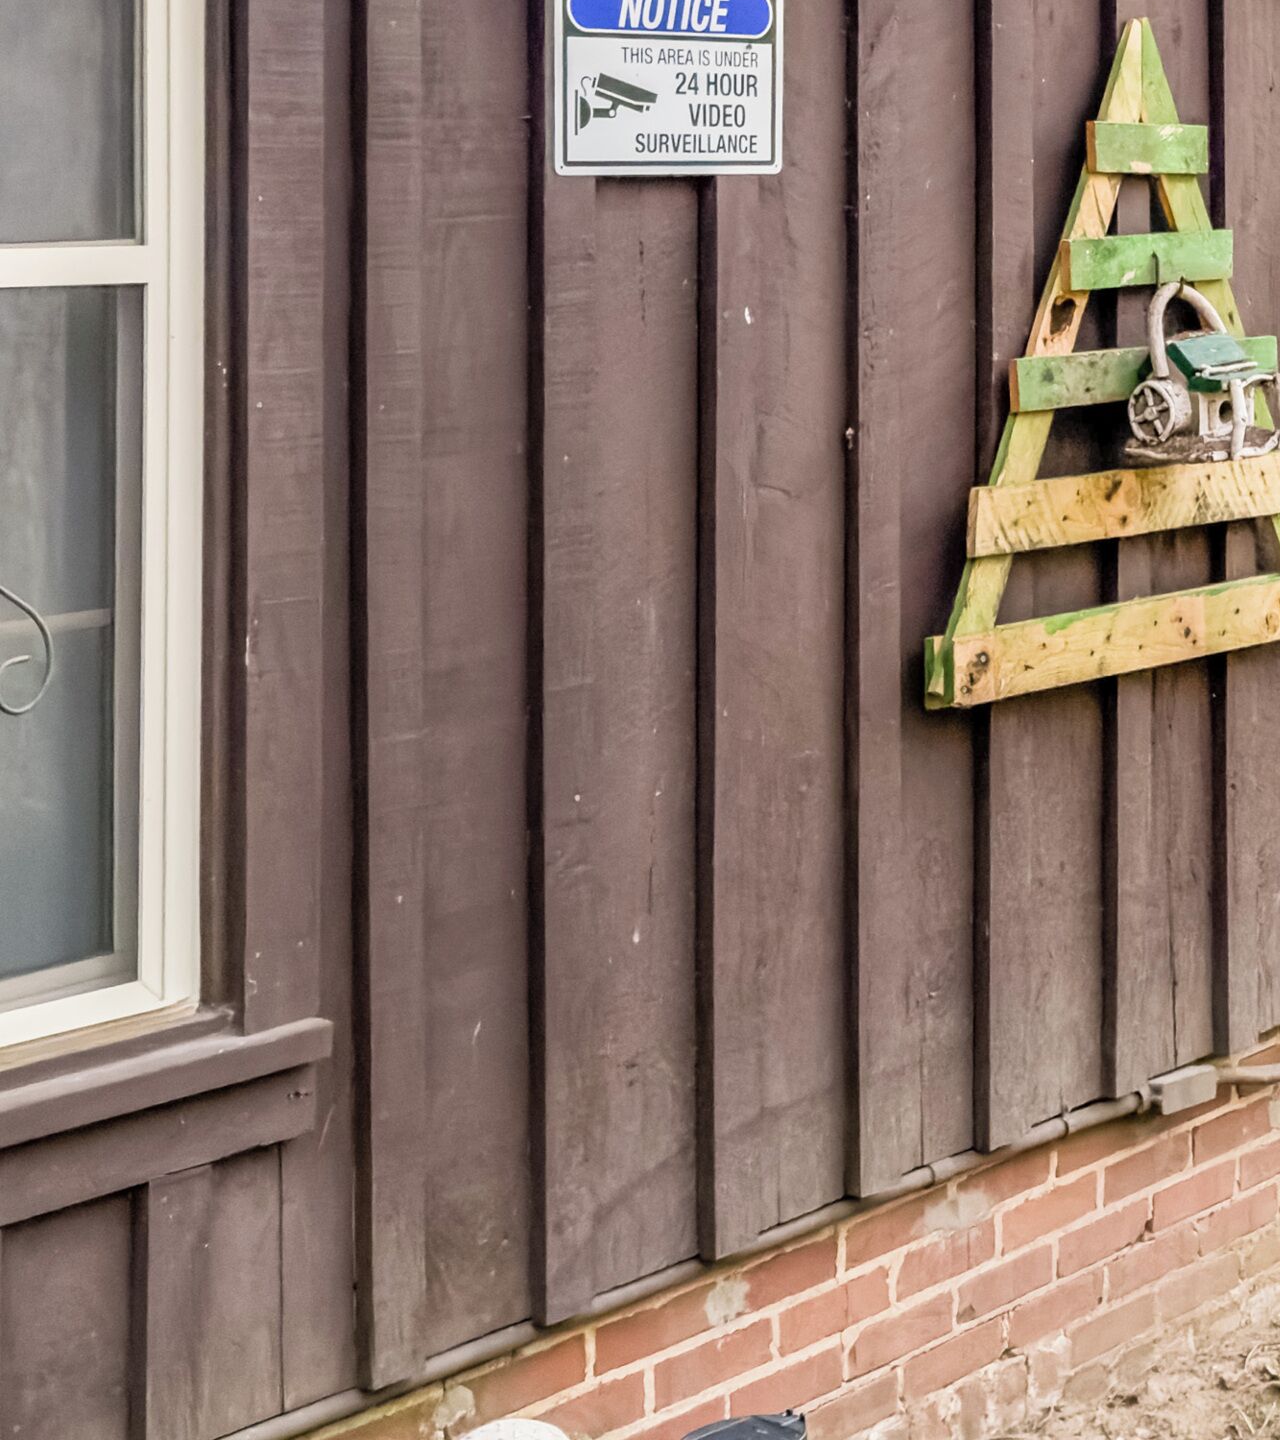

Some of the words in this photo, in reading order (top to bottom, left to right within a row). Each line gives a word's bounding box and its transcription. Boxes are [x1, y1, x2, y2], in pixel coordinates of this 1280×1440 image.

[621, 47, 653, 64] THIS
[657, 49, 694, 66] AREA
[699, 50, 710, 67] IS
[715, 51, 758, 68] UNDER
[675, 72, 699, 95] 24
[706, 73, 758, 97] HOUR
[689, 103, 746, 128] VIDEO
[635, 133, 758, 154] SURVEILLANCE
